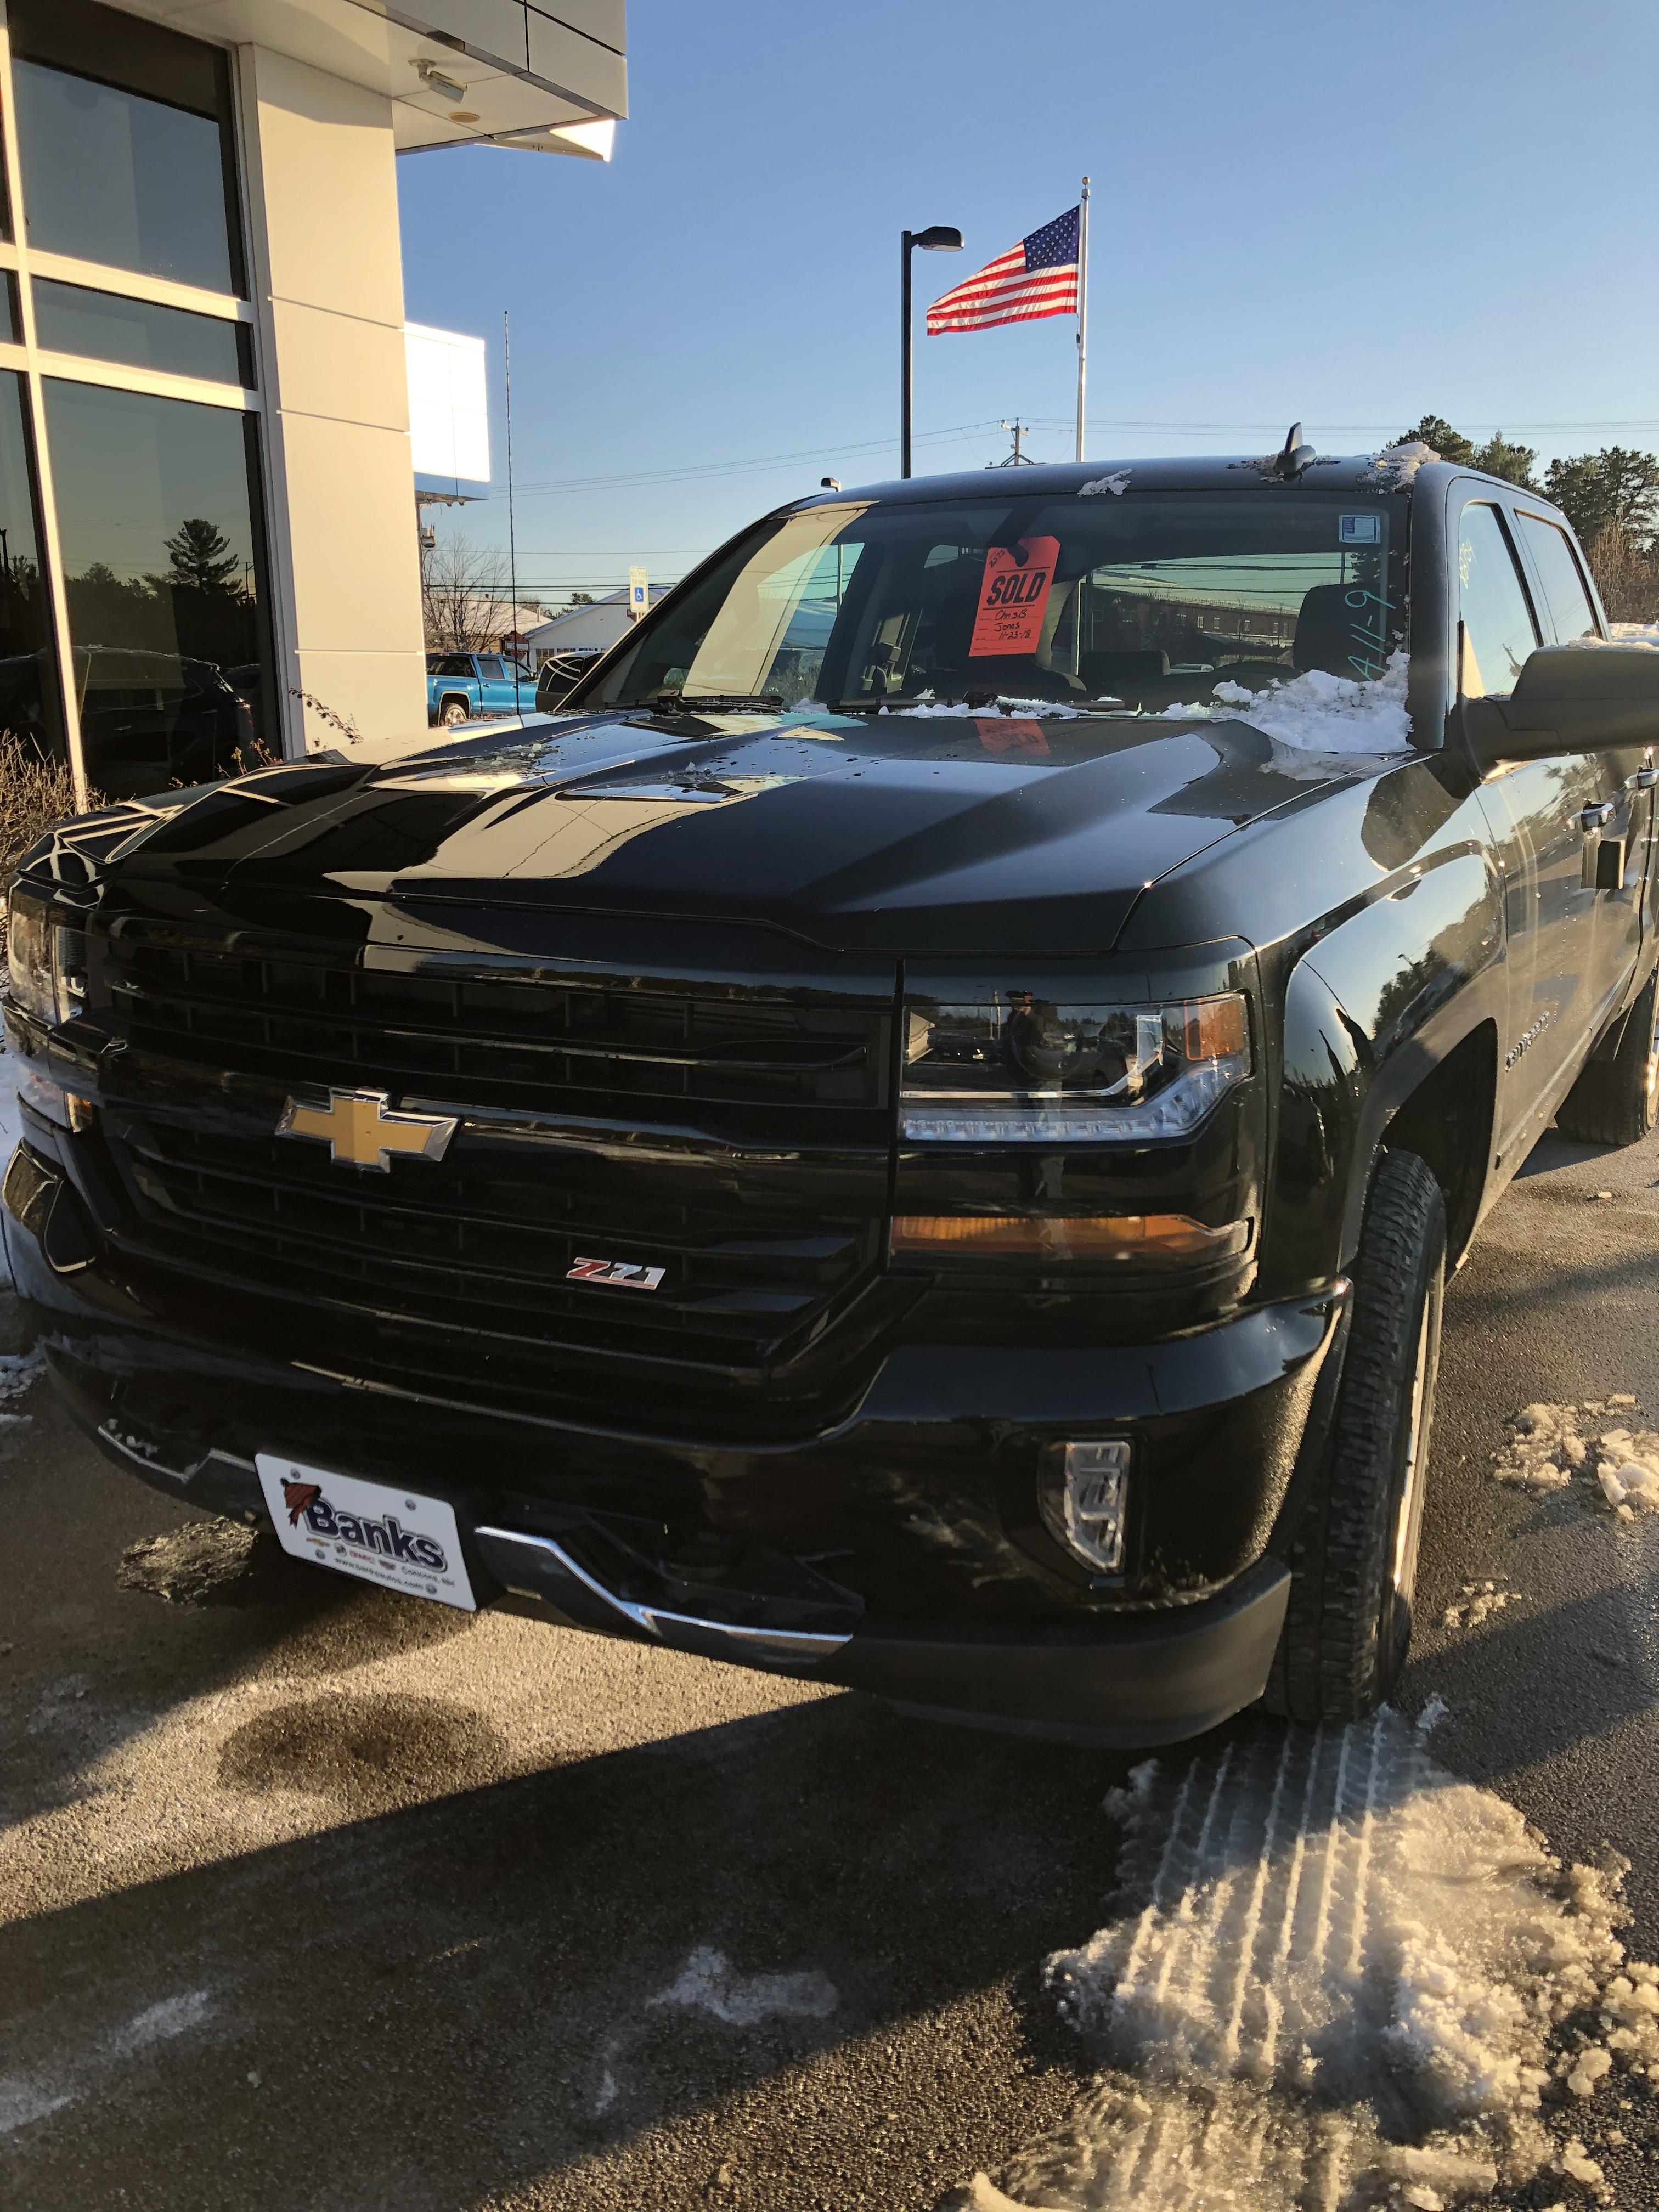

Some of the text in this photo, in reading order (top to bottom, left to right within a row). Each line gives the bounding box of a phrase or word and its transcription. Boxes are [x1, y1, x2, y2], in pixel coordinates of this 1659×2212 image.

[987, 572, 1046, 605] SOLD
[566, 1257, 666, 1290] Z71
[303, 1496, 448, 1573] Banks
